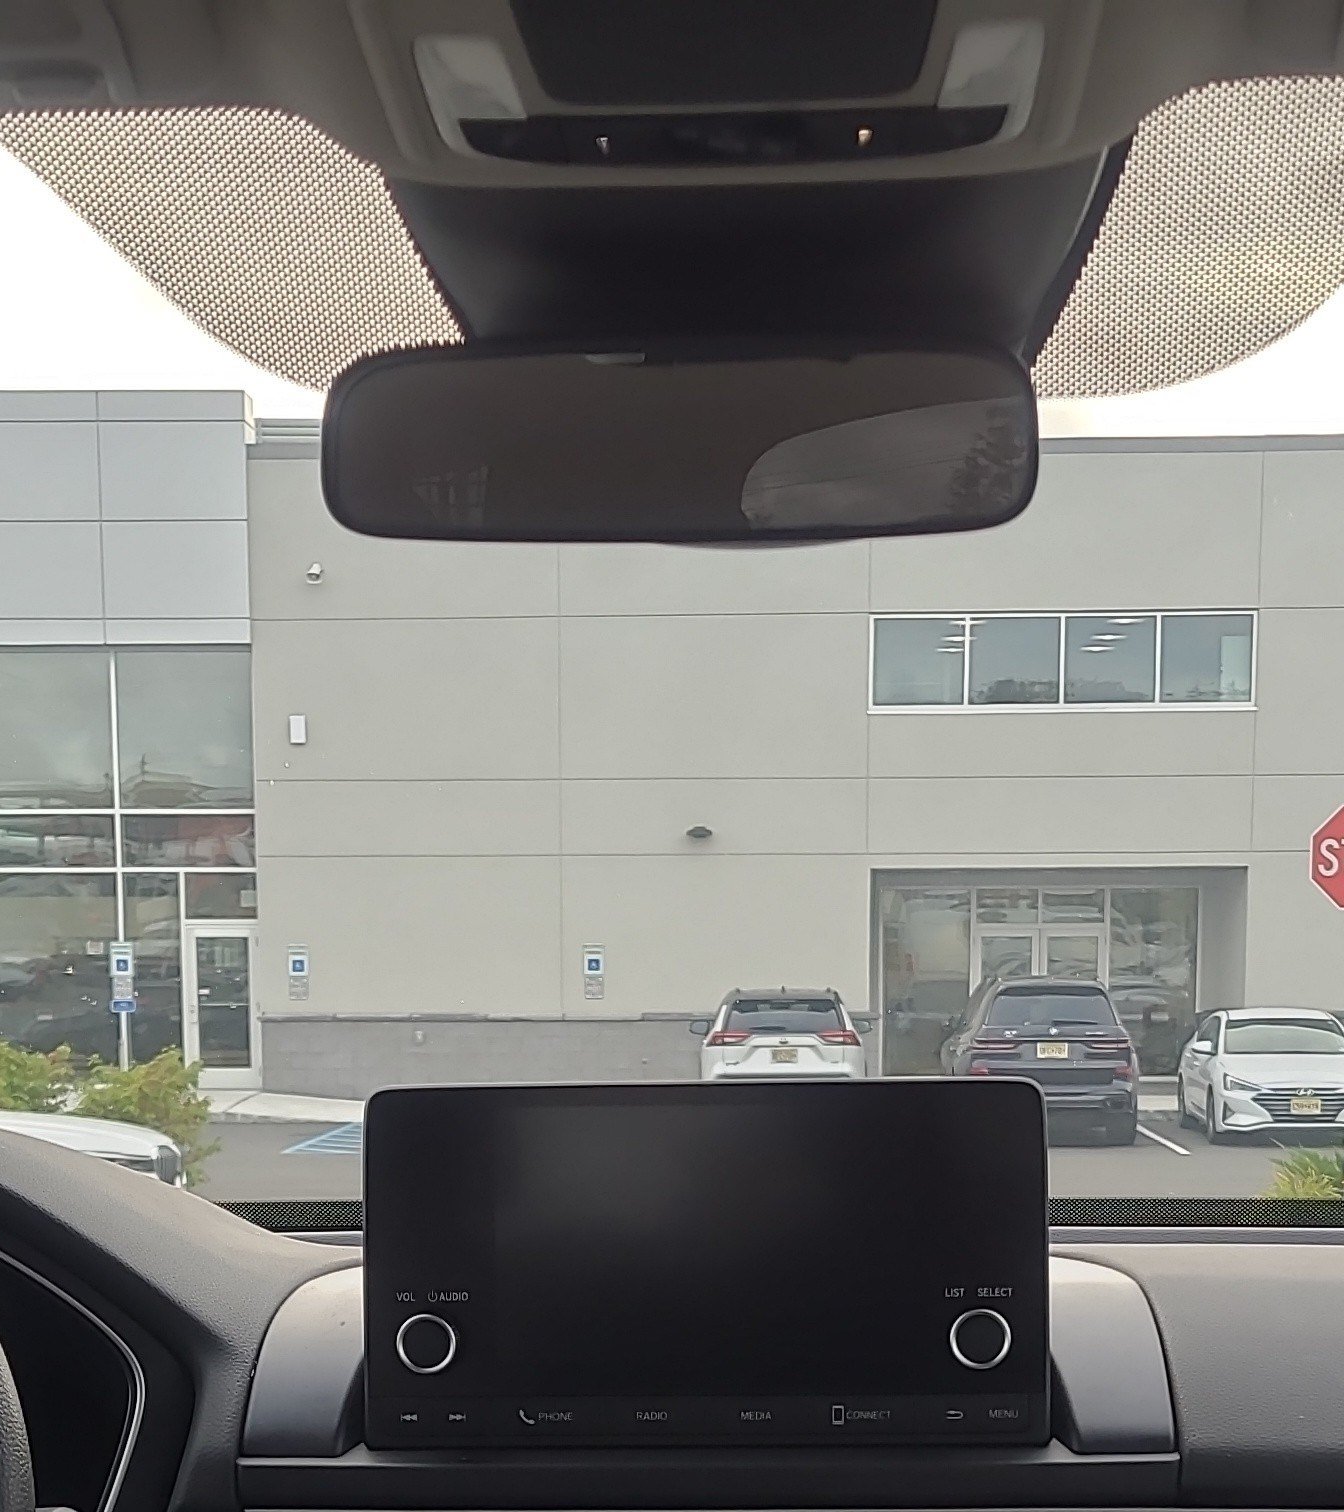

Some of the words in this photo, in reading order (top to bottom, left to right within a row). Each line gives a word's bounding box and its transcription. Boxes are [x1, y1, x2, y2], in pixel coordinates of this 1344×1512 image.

[395, 1291, 416, 1302] VOL
[439, 1291, 469, 1302] AUDIO
[944, 1287, 964, 1298] LIST
[977, 1287, 1013, 1298] SELECT
[538, 1411, 573, 1422] PHONE
[636, 1411, 668, 1421] RADIO
[740, 1411, 772, 1421] MEDIA
[989, 1408, 1019, 1419] MENU
